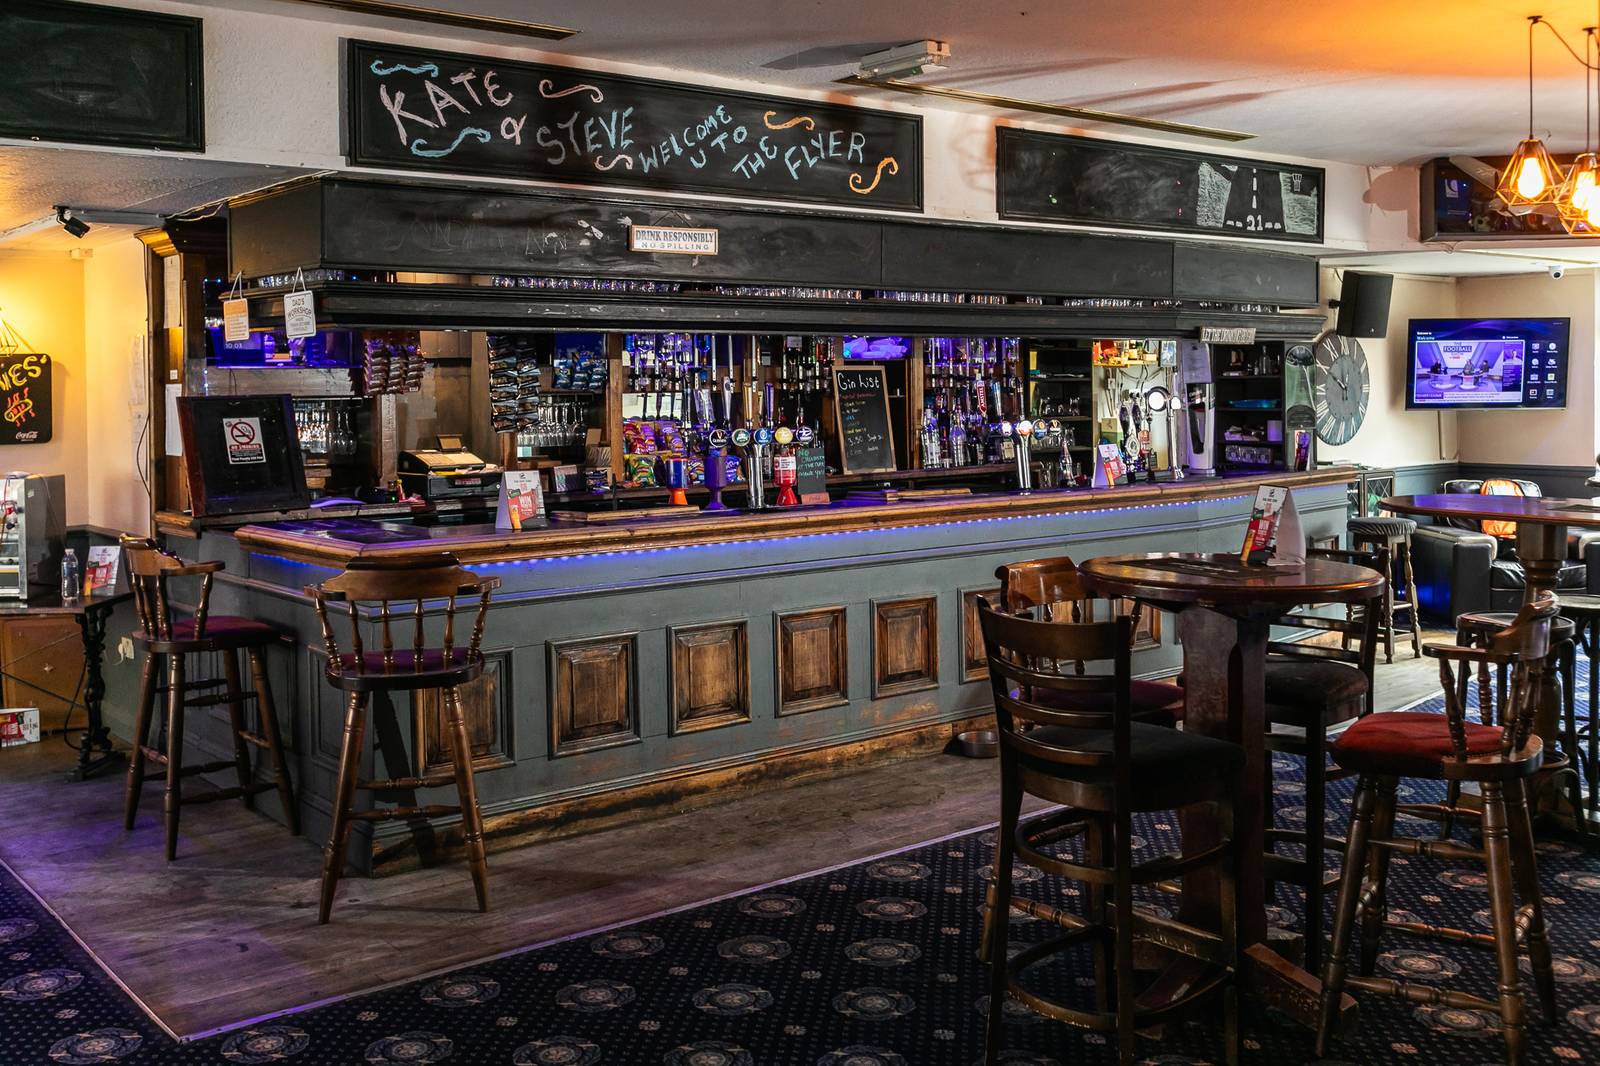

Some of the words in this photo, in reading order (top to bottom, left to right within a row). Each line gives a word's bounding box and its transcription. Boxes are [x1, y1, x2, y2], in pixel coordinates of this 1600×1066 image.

[380, 68, 513, 146] KATE
[536, 106, 634, 165] STEVE
[639, 104, 732, 173] WELCOME
[711, 126, 748, 153] TO
[731, 136, 778, 179] THE
[784, 130, 866, 180] FLYER
[635, 230, 661, 241] DRINK
[663, 231, 714, 243] RESPONSIBLY
[659, 242, 709, 250] SPILLING
[837, 372, 856, 390] Gin
[858, 373, 880, 389] List
